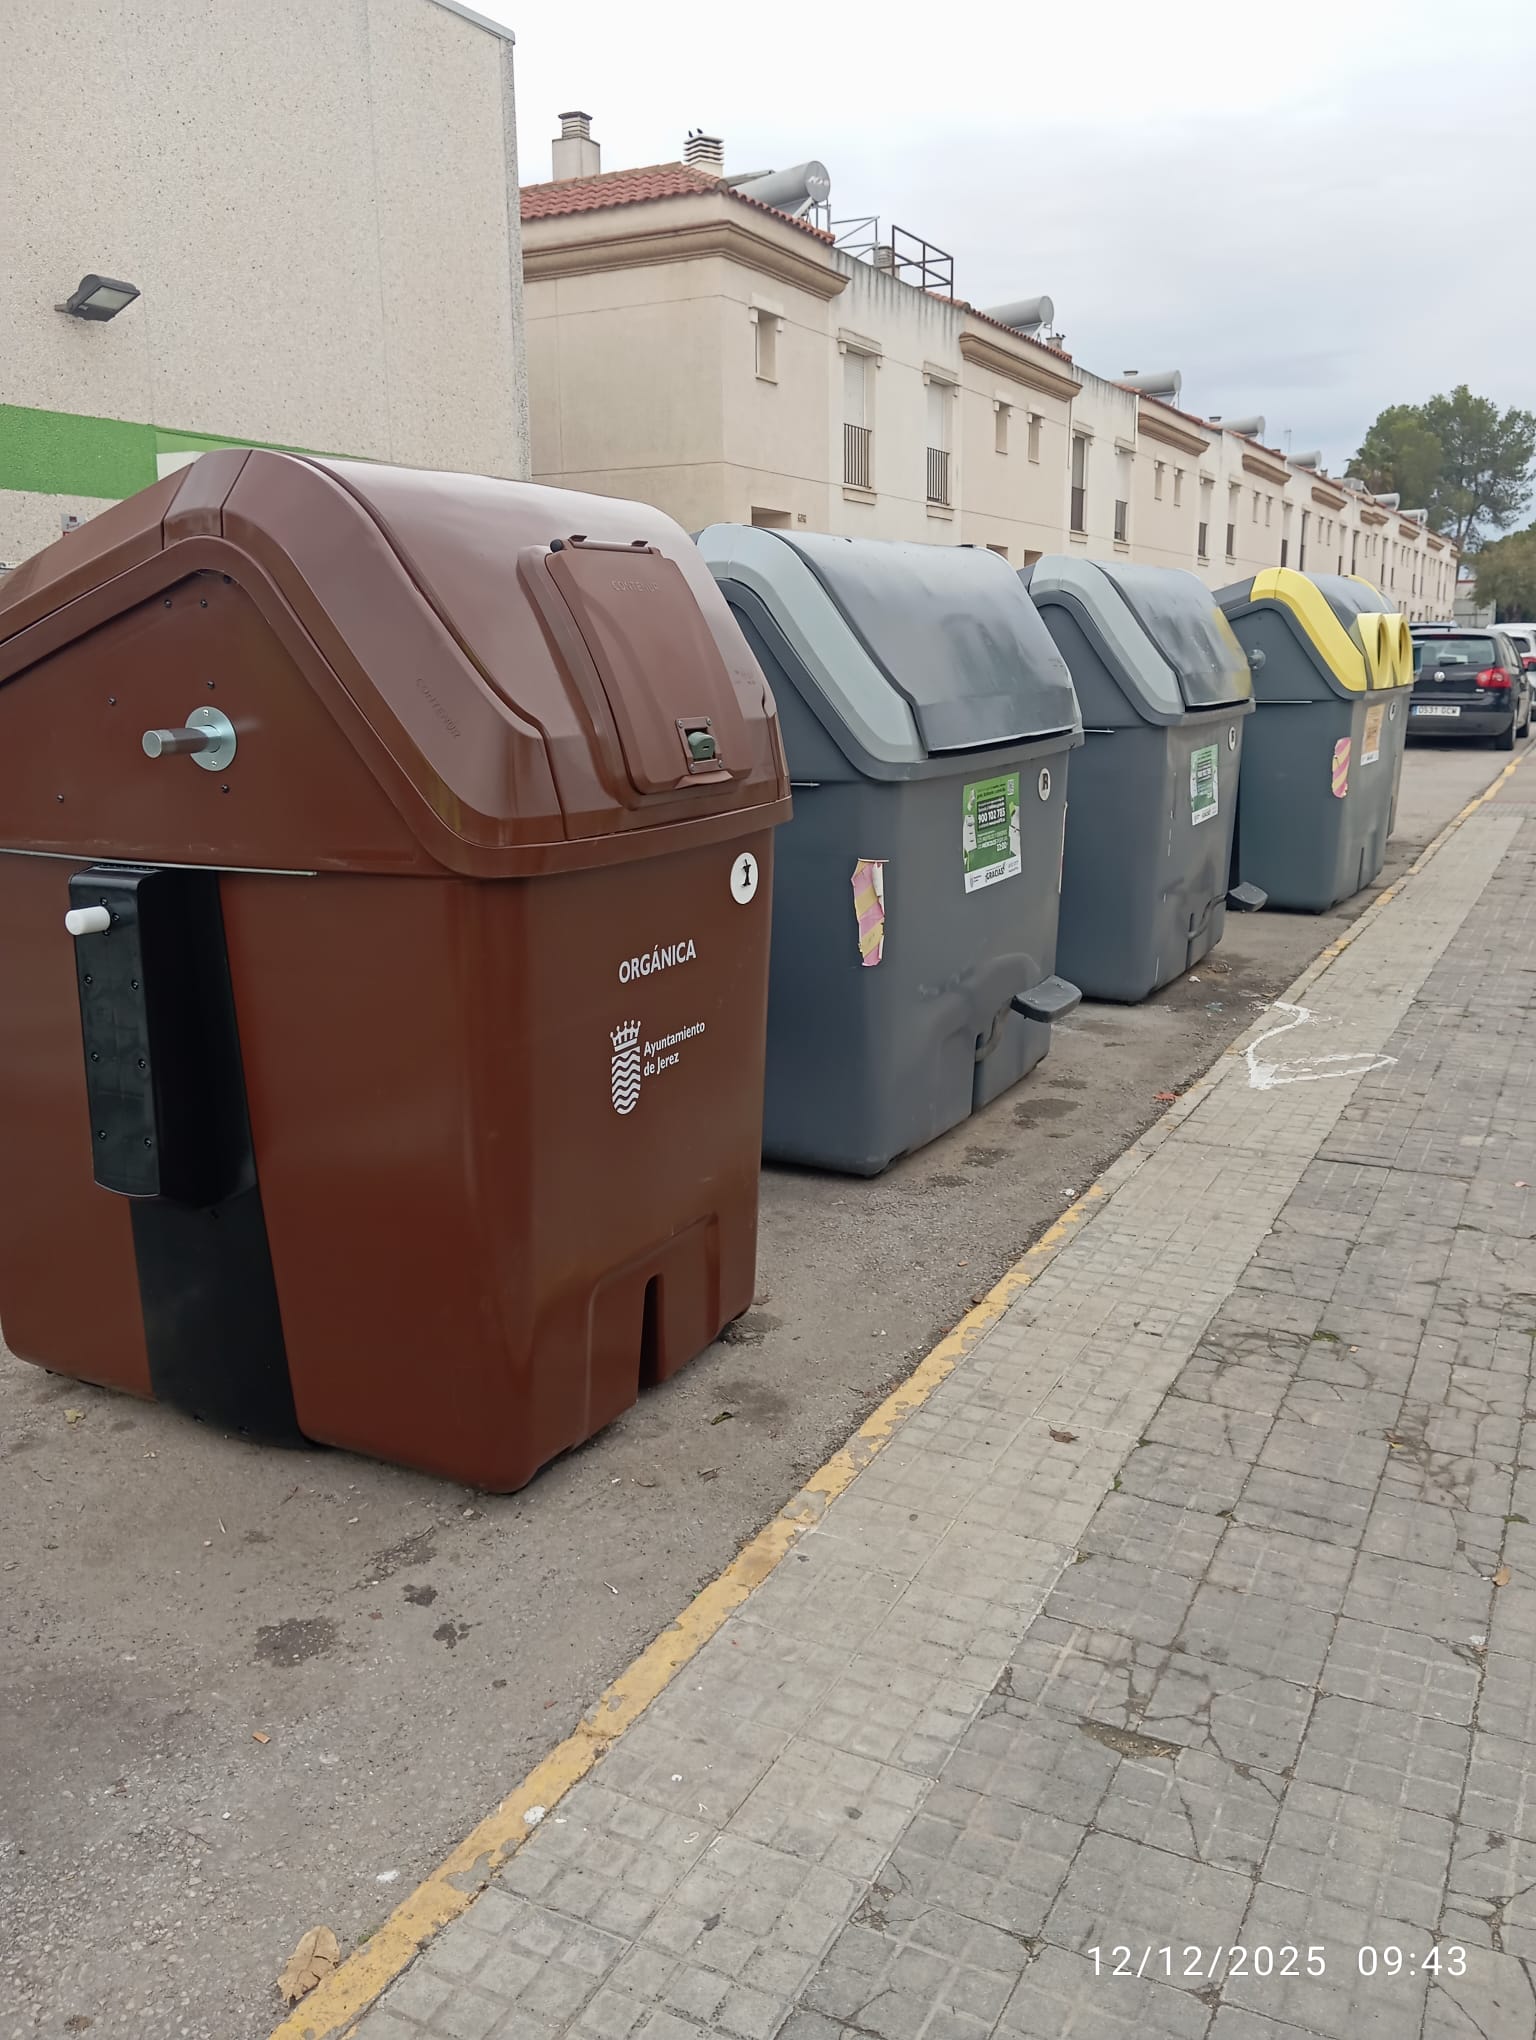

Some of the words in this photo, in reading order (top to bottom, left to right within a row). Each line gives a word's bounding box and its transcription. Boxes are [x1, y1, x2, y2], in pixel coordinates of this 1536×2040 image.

[619, 939, 697, 983] ORGÁNICA
[644, 1023, 705, 1057] Ayuntamiento
[643, 1061, 656, 1077] de
[657, 1052, 680, 1075] Jerez
